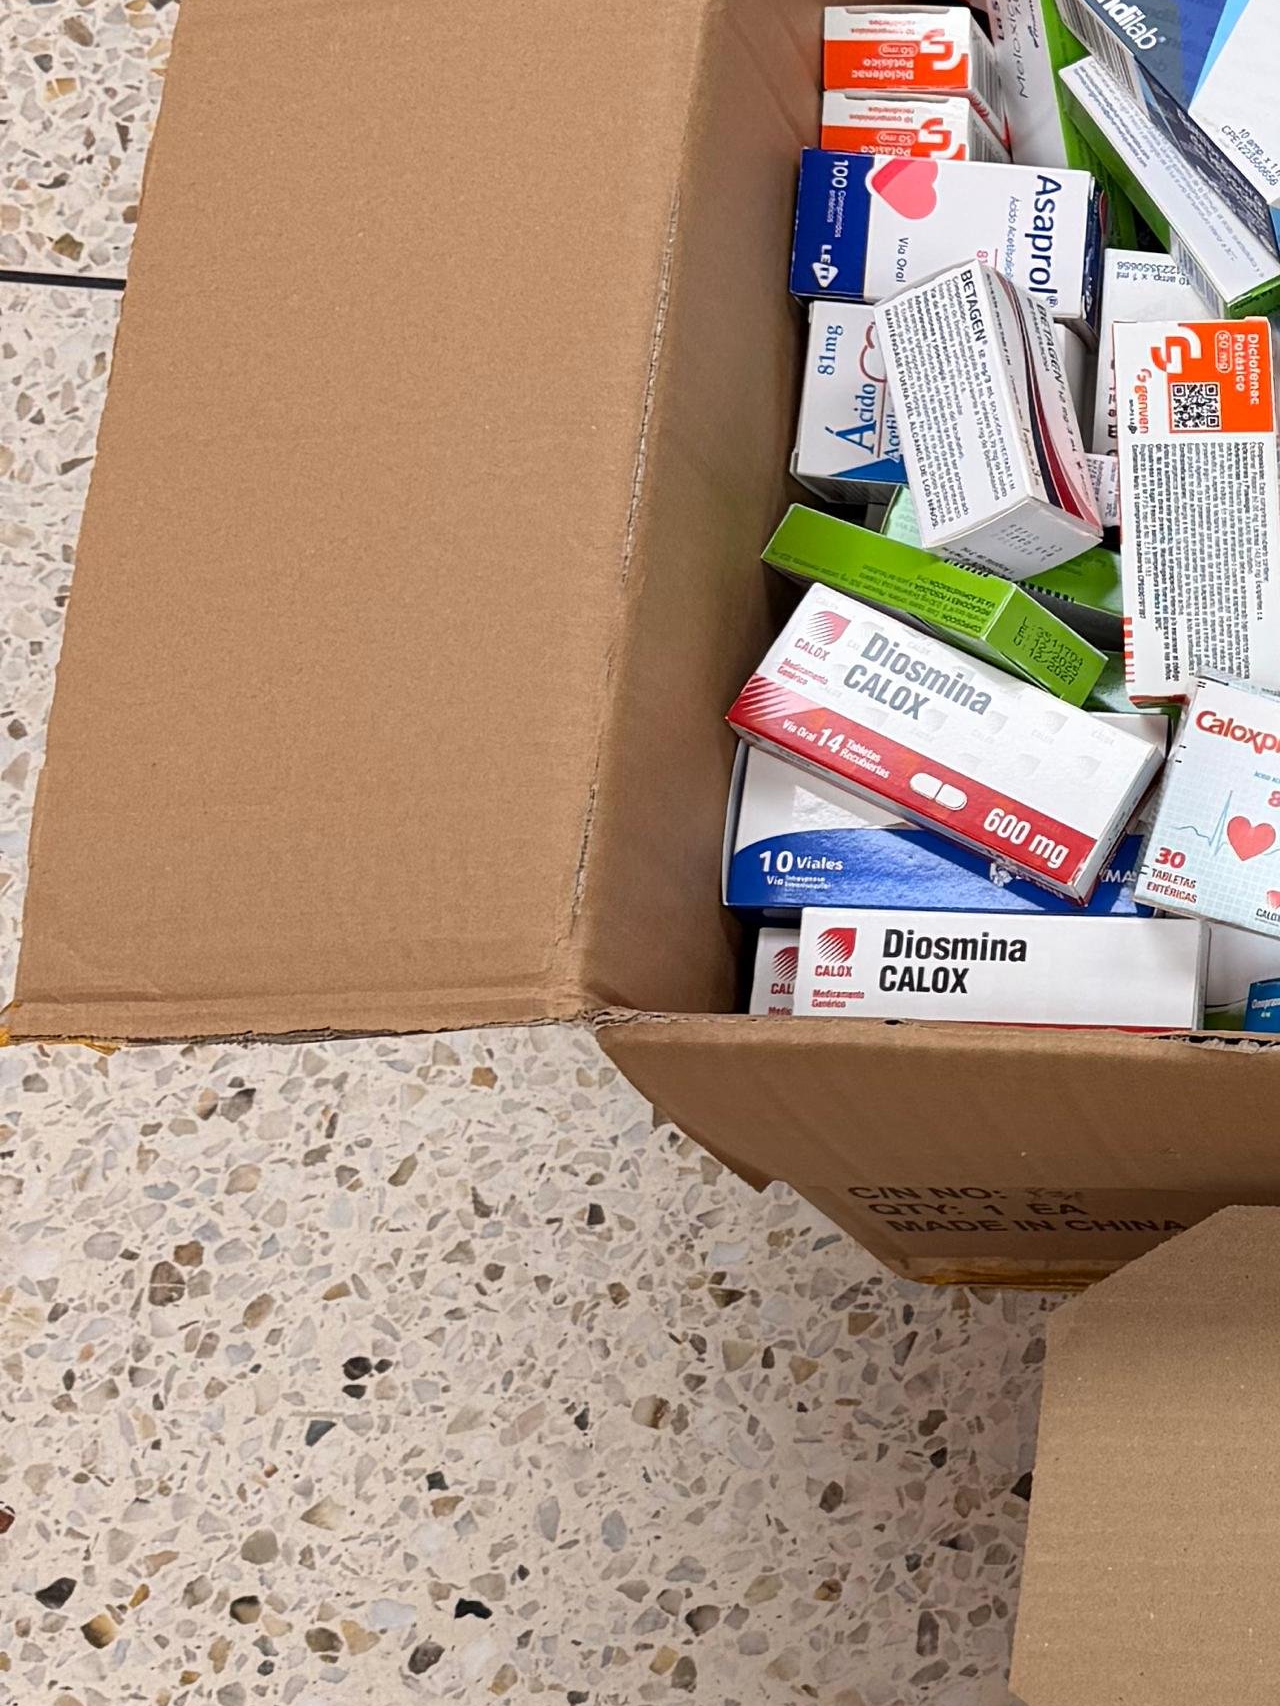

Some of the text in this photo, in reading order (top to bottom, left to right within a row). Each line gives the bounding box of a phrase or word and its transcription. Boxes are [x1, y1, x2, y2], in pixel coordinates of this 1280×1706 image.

[831, 160, 849, 187] 100
[960, 269, 986, 339] BETAGEN
[817, 324, 844, 374] 81mg
[1234, 333, 1245, 392] Potásico
[1247, 333, 1259, 406] Diclofenac
[824, 383, 877, 453] Ácido
[1134, 385, 1150, 434] genven
[793, 638, 831, 662] CALOX
[860, 632, 992, 715] Diosmina
[842, 664, 930, 721] CALOX
[797, 725, 842, 754] Oral 14
[982, 807, 1070, 870] 600 mg
[759, 851, 843, 873] 10 Viales
[1154, 847, 1187, 869] 30
[1151, 868, 1197, 890] TABLETAS
[881, 928, 1028, 962] Diosmina
[815, 965, 852, 978] CALOX
[878, 965, 970, 994] CALOX
[1025, 1203, 1089, 1215] EA
[885, 1220, 1192, 1232] MADE IN CHINA
